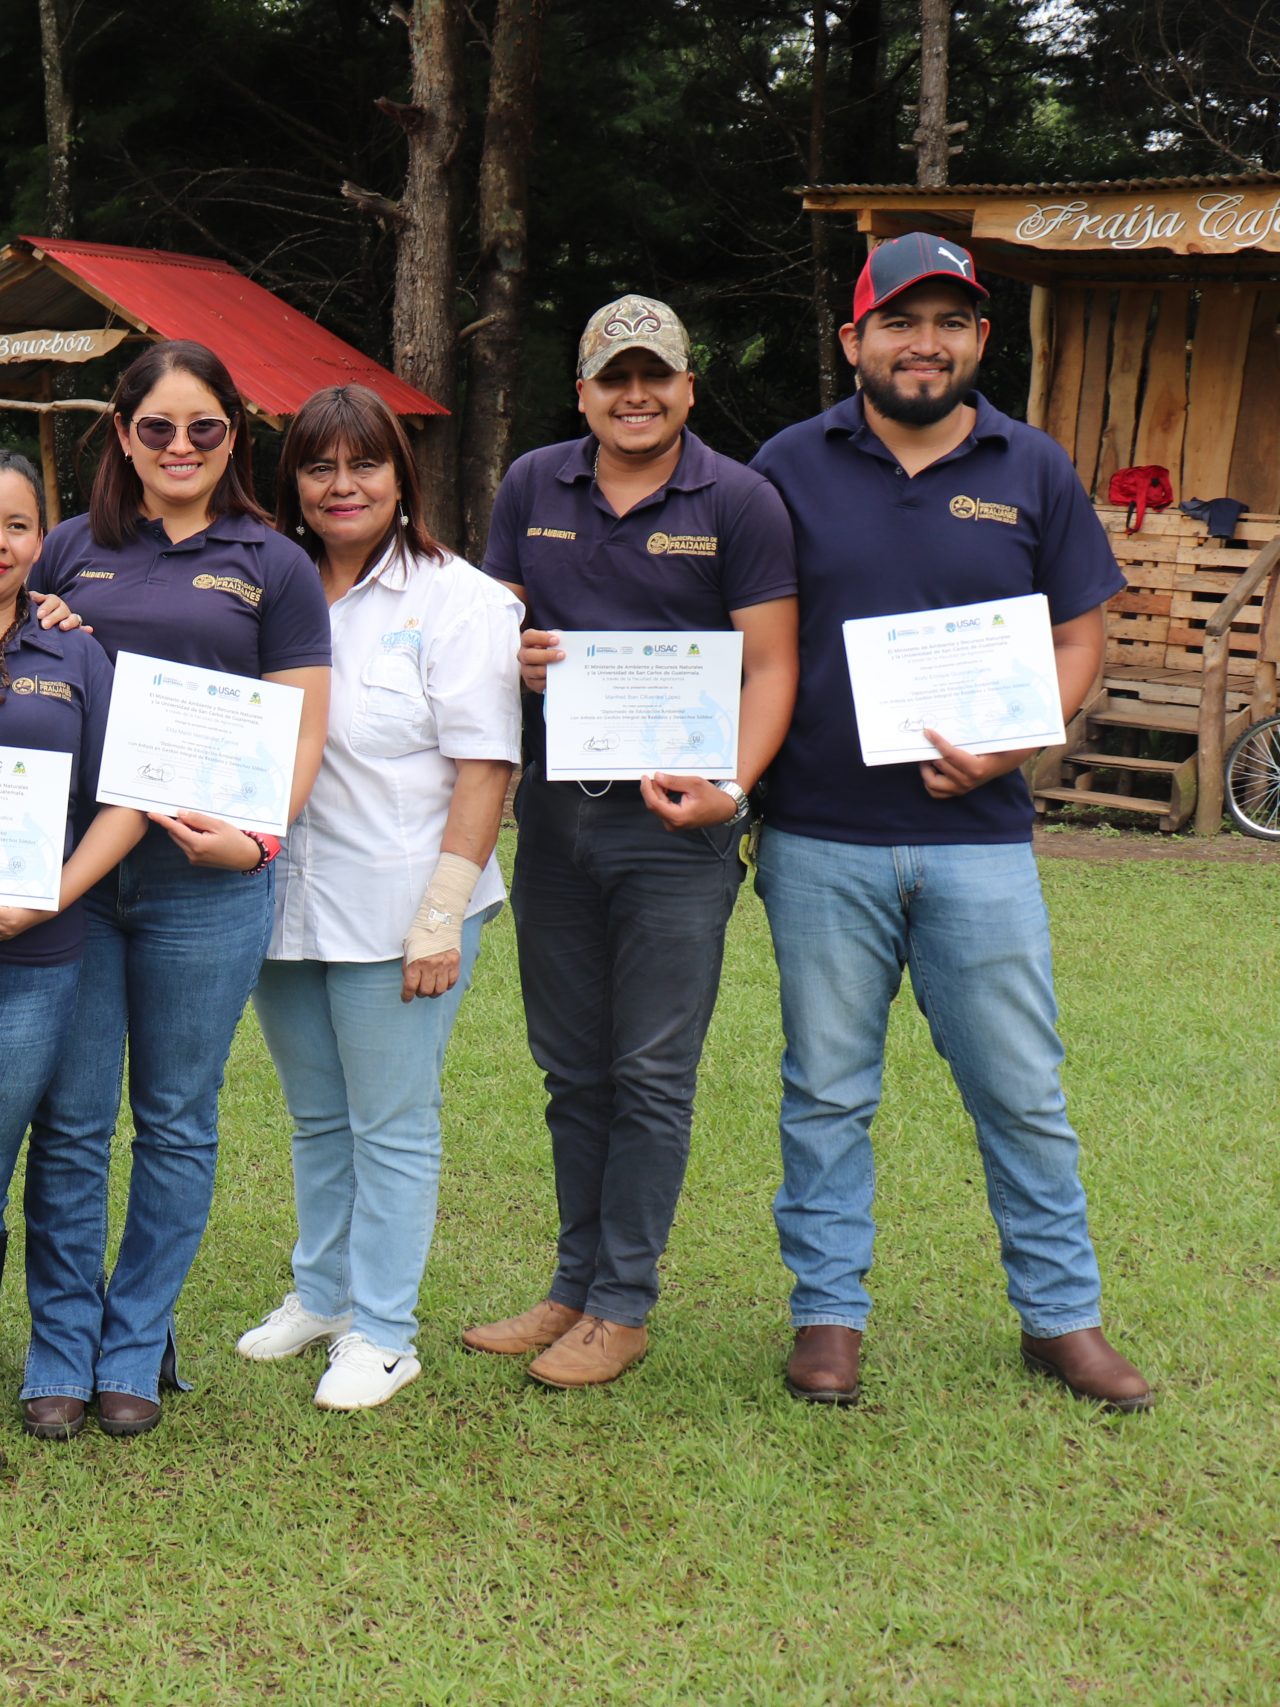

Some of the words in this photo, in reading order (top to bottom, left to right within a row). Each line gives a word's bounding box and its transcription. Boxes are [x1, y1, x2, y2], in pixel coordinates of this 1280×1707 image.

[1016, 201, 1187, 249] Fraija
[1197, 193, 1280, 247] Caf
[542, 528, 576, 540] AMBIENTE
[670, 542, 717, 551] FRAIJANES
[80, 570, 115, 580] AMBIENTE
[218, 576, 255, 592] MUNICIPALIDAD
[217, 581, 261, 602] FRAIJANES
[956, 617, 981, 628] USAC
[654, 644, 677, 652] USAC
[39, 685, 71, 698] FRAIJANES
[217, 685, 241, 697] USAC
